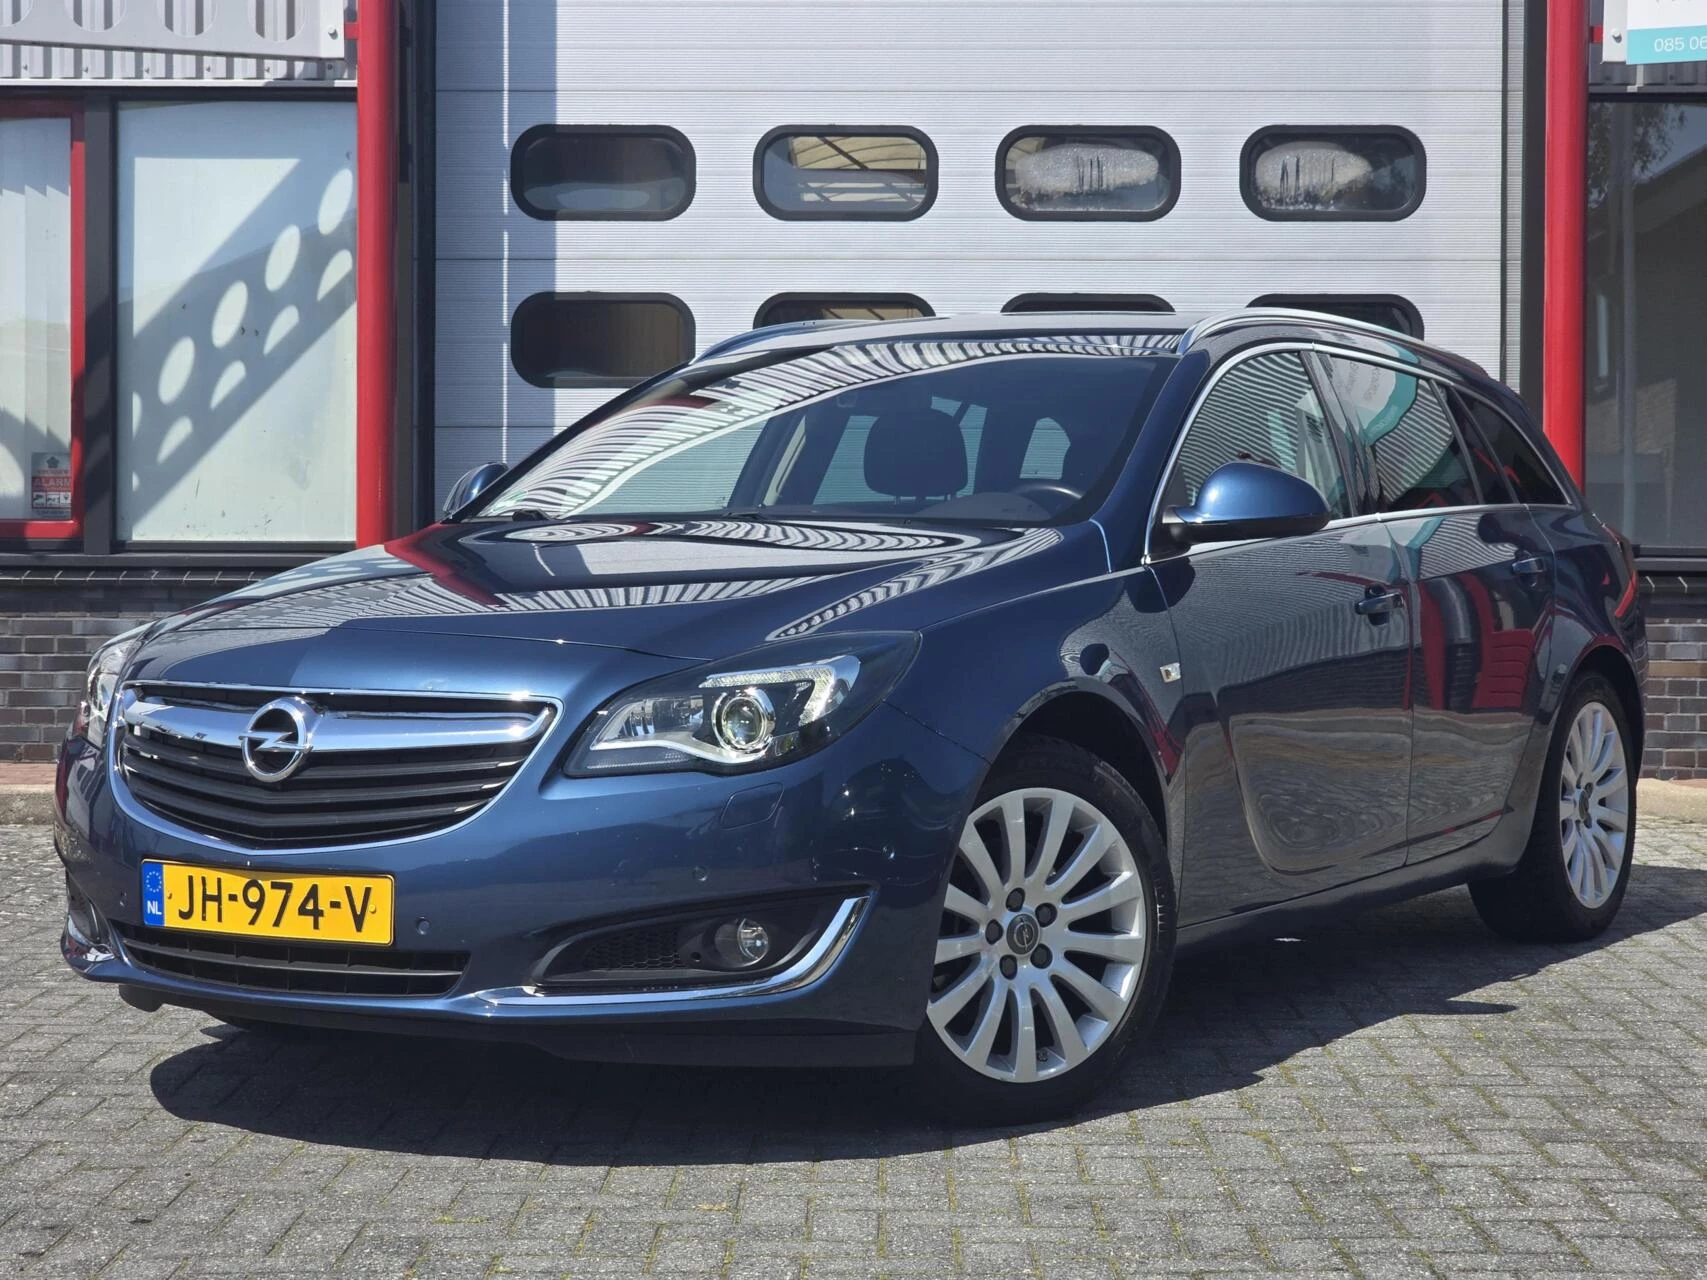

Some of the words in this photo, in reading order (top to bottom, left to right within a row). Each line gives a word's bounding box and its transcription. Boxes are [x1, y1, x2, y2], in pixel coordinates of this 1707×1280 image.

[1654, 37, 1685, 53] 085
[147, 900, 162, 915] NL
[178, 874, 372, 933] JH-974-V
